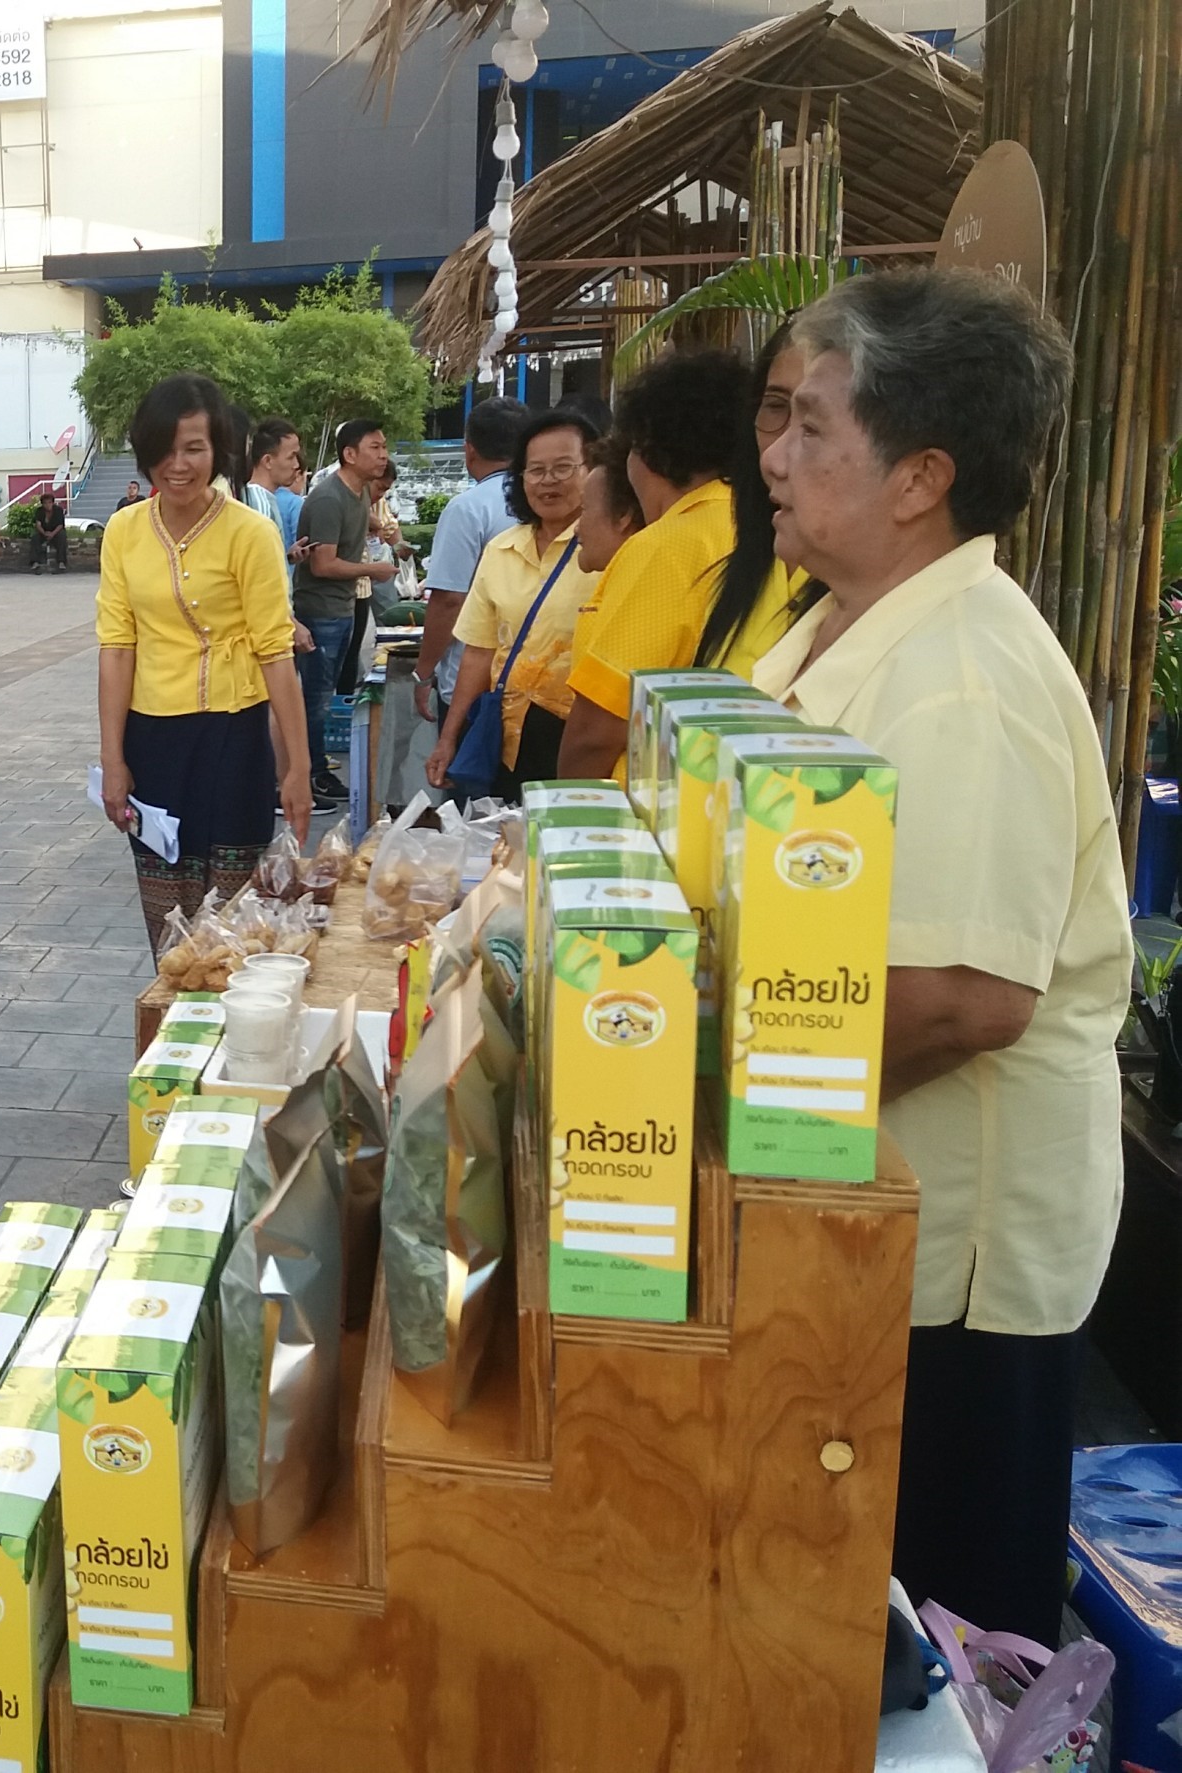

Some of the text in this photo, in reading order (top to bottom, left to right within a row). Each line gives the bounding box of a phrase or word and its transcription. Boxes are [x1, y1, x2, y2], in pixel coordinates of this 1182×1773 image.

[752, 966, 870, 1004] กล้วยไข่
[750, 1010, 843, 1029] ทอดกรอบ
[567, 1120, 677, 1155] กล้วยไข่
[563, 1160, 652, 1178] ทอดกรอบ
[76, 1537, 169, 1570] กล้วยไข่
[76, 1571, 150, 1589] ทอดกรอบ
